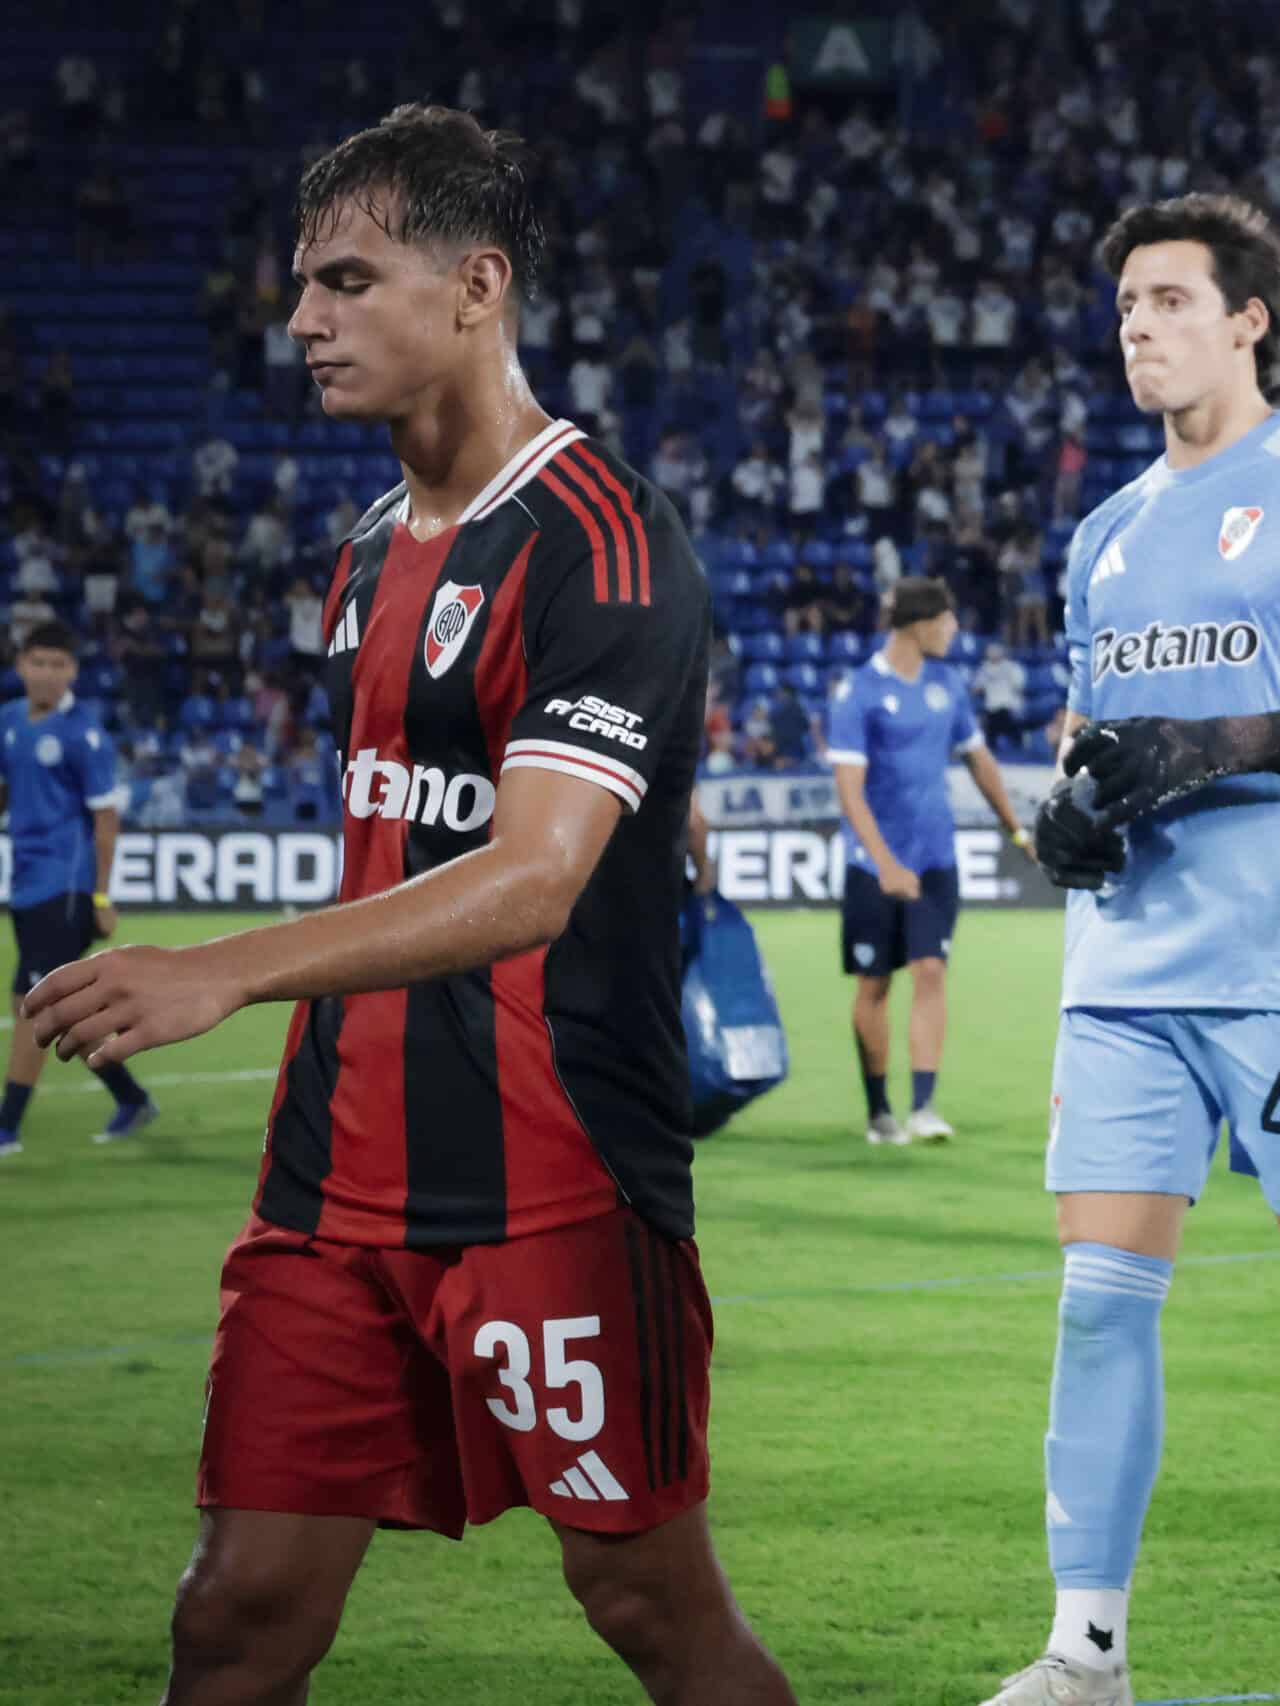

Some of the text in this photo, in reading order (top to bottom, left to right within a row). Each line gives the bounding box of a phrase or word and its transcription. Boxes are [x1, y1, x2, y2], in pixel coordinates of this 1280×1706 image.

[811, 24, 870, 77] A
[543, 695, 644, 729] ASIST
[567, 711, 649, 750] CARD
[338, 747, 497, 832] tano
[473, 1315, 605, 1442] 35
